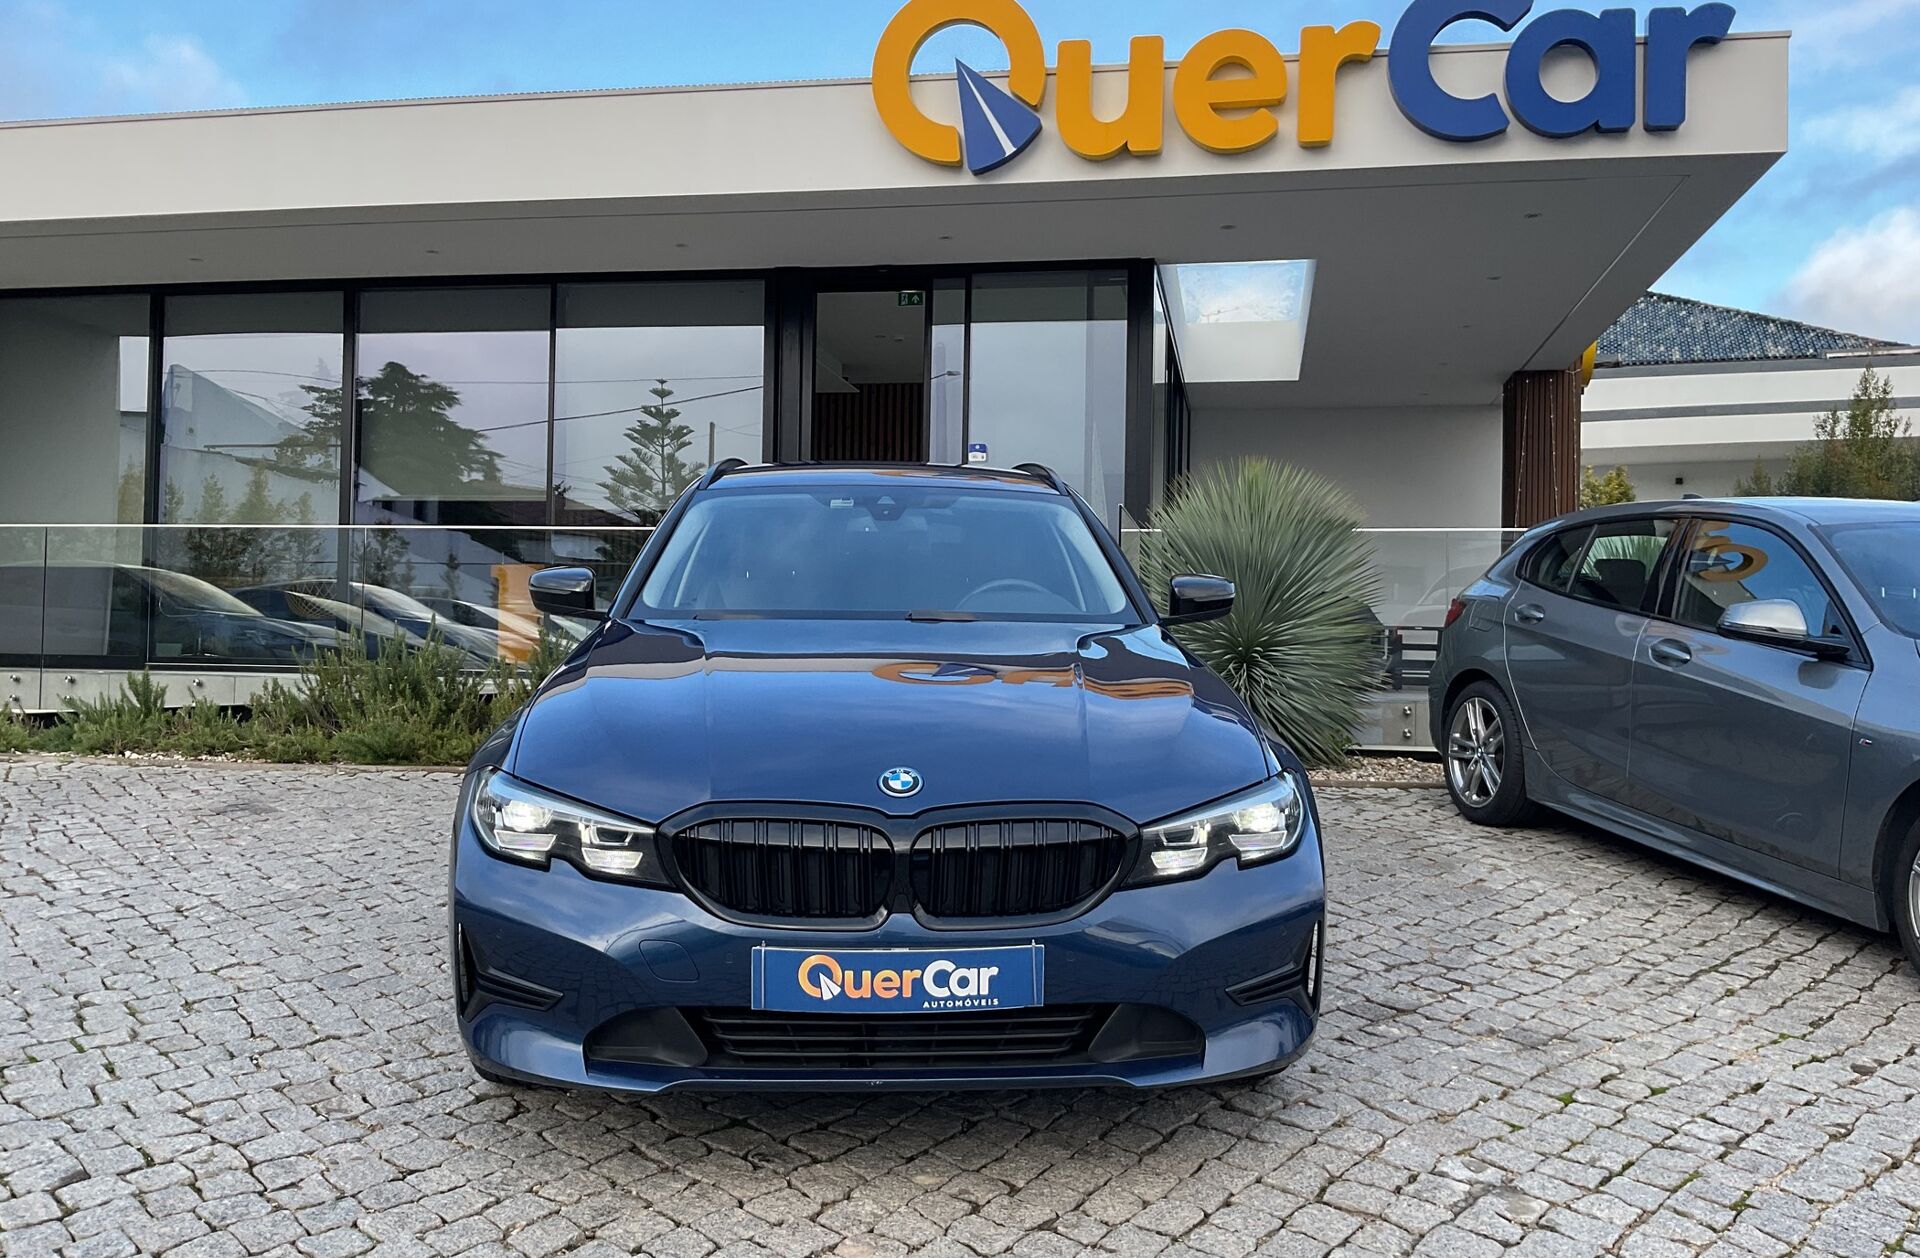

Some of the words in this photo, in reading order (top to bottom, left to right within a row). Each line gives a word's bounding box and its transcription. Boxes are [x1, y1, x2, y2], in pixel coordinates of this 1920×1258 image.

[872, 0, 1736, 176] QuerCar
[798, 954, 999, 1000] QuerCar
[922, 998, 999, 1008] AUTOMÓVEIS
